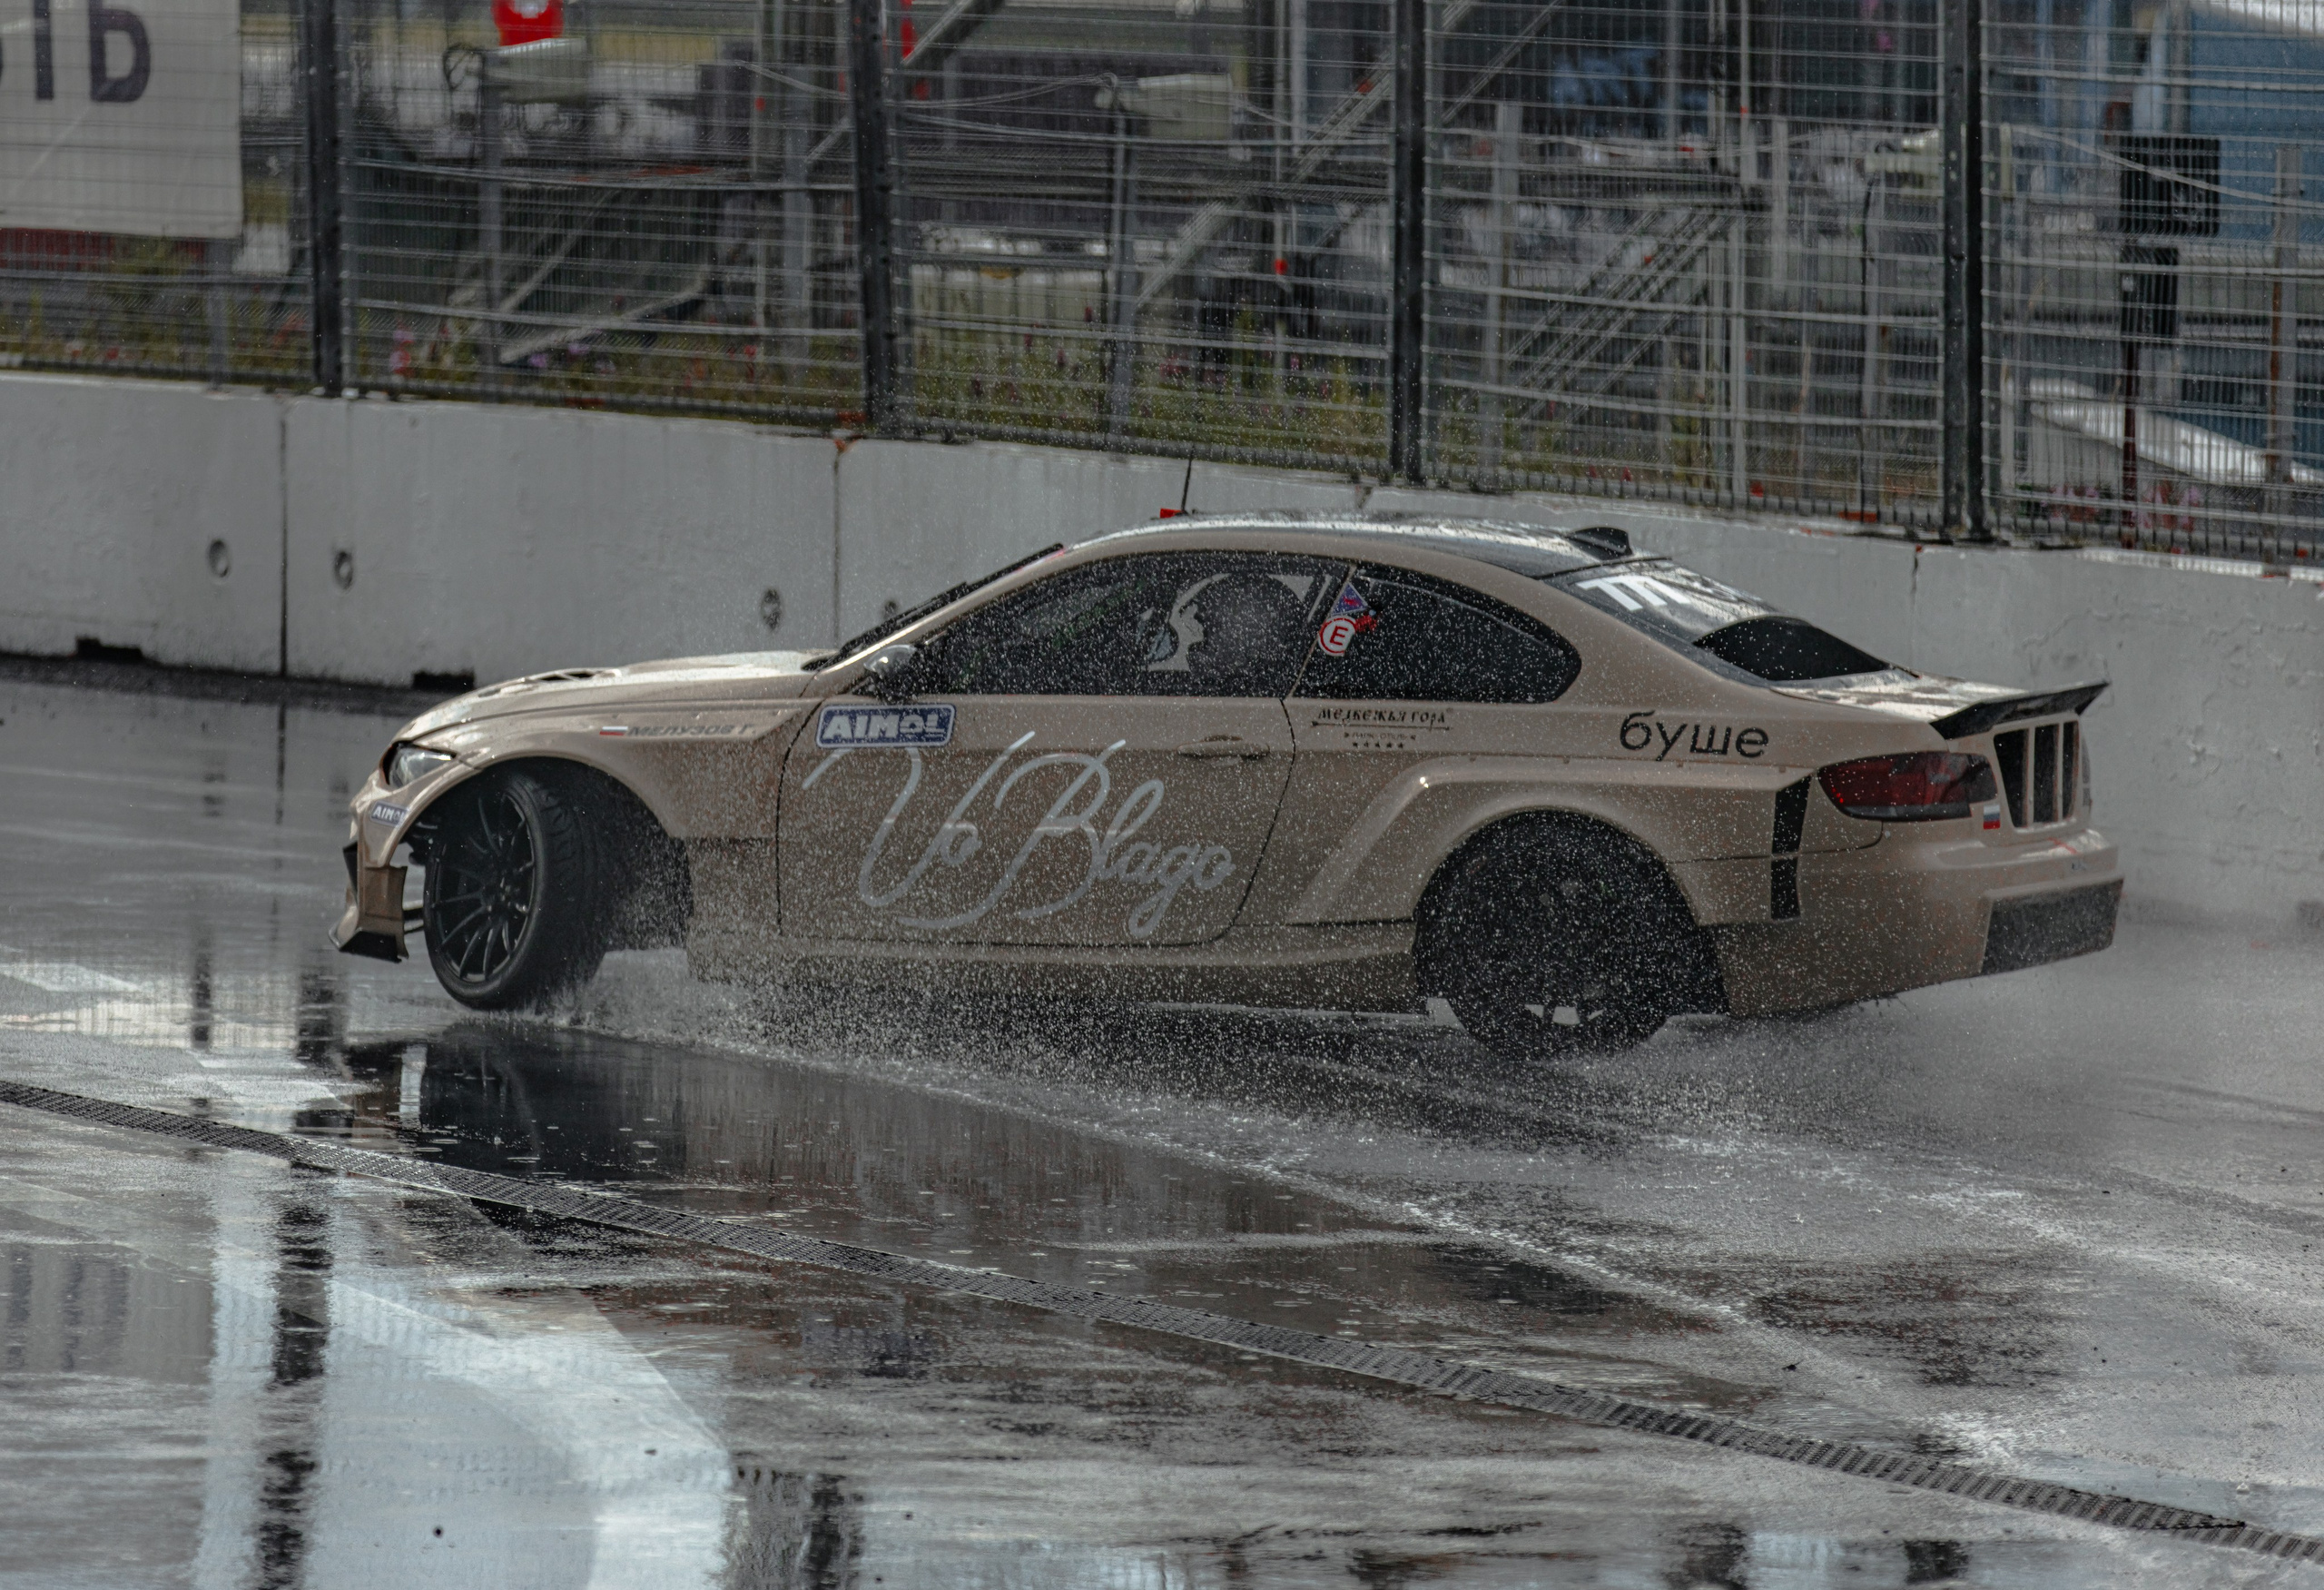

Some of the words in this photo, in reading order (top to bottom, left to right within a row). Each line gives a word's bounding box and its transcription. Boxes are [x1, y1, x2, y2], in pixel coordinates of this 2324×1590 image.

[1329, 625, 1349, 647] E
[822, 714, 945, 739] AIMOL
[1620, 709, 1769, 762] буше
